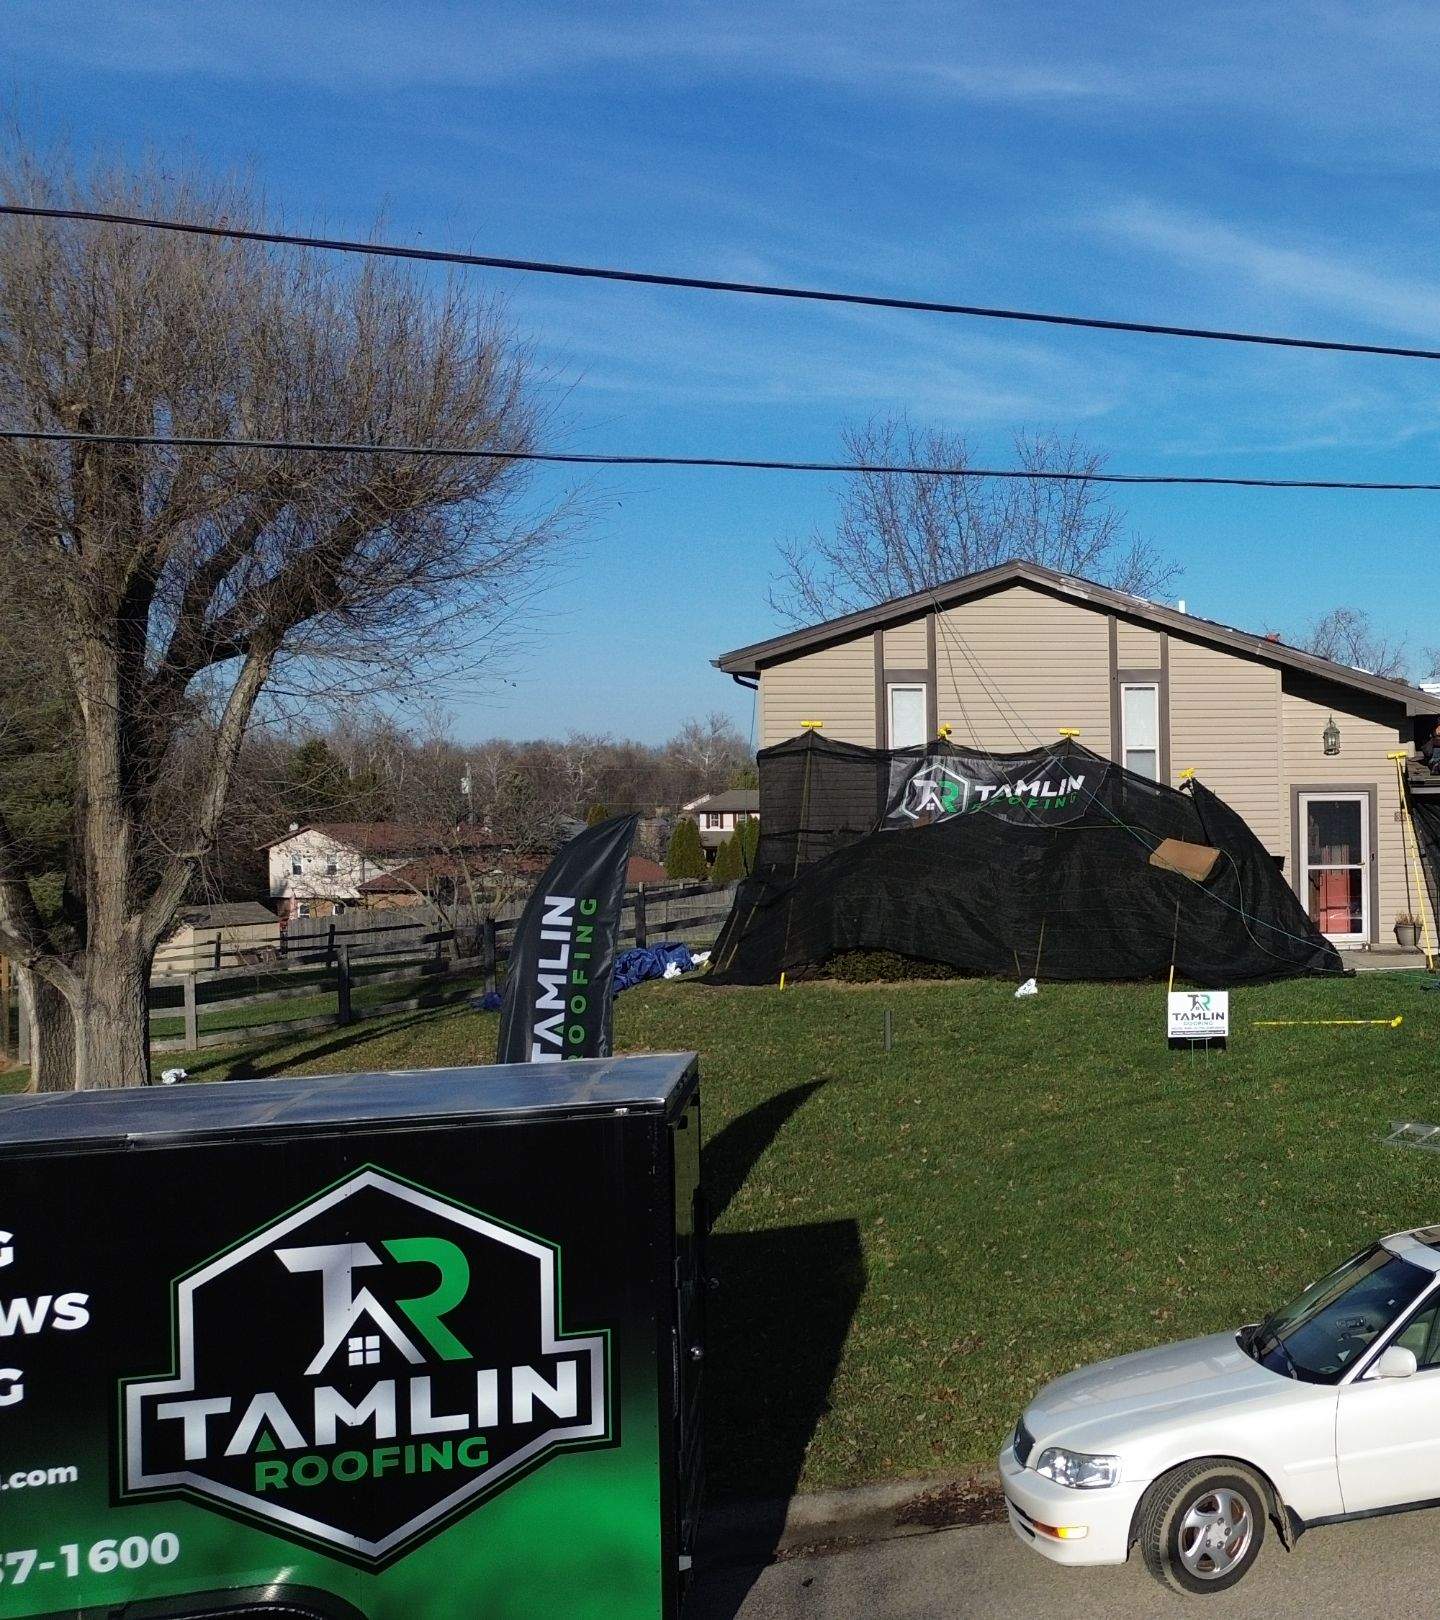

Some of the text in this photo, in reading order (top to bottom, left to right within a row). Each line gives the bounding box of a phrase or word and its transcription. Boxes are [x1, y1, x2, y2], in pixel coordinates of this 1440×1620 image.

[975, 775, 1085, 801] TAMLIN
[531, 895, 576, 1064] TAMLIN
[1172, 1012, 1225, 1020] TAMLIN
[273, 1237, 473, 1375] TR
[157, 1360, 578, 1461] TAMLIN
[254, 1436, 489, 1492] ROOFING
[0, 1532, 180, 1585] 7-1600
